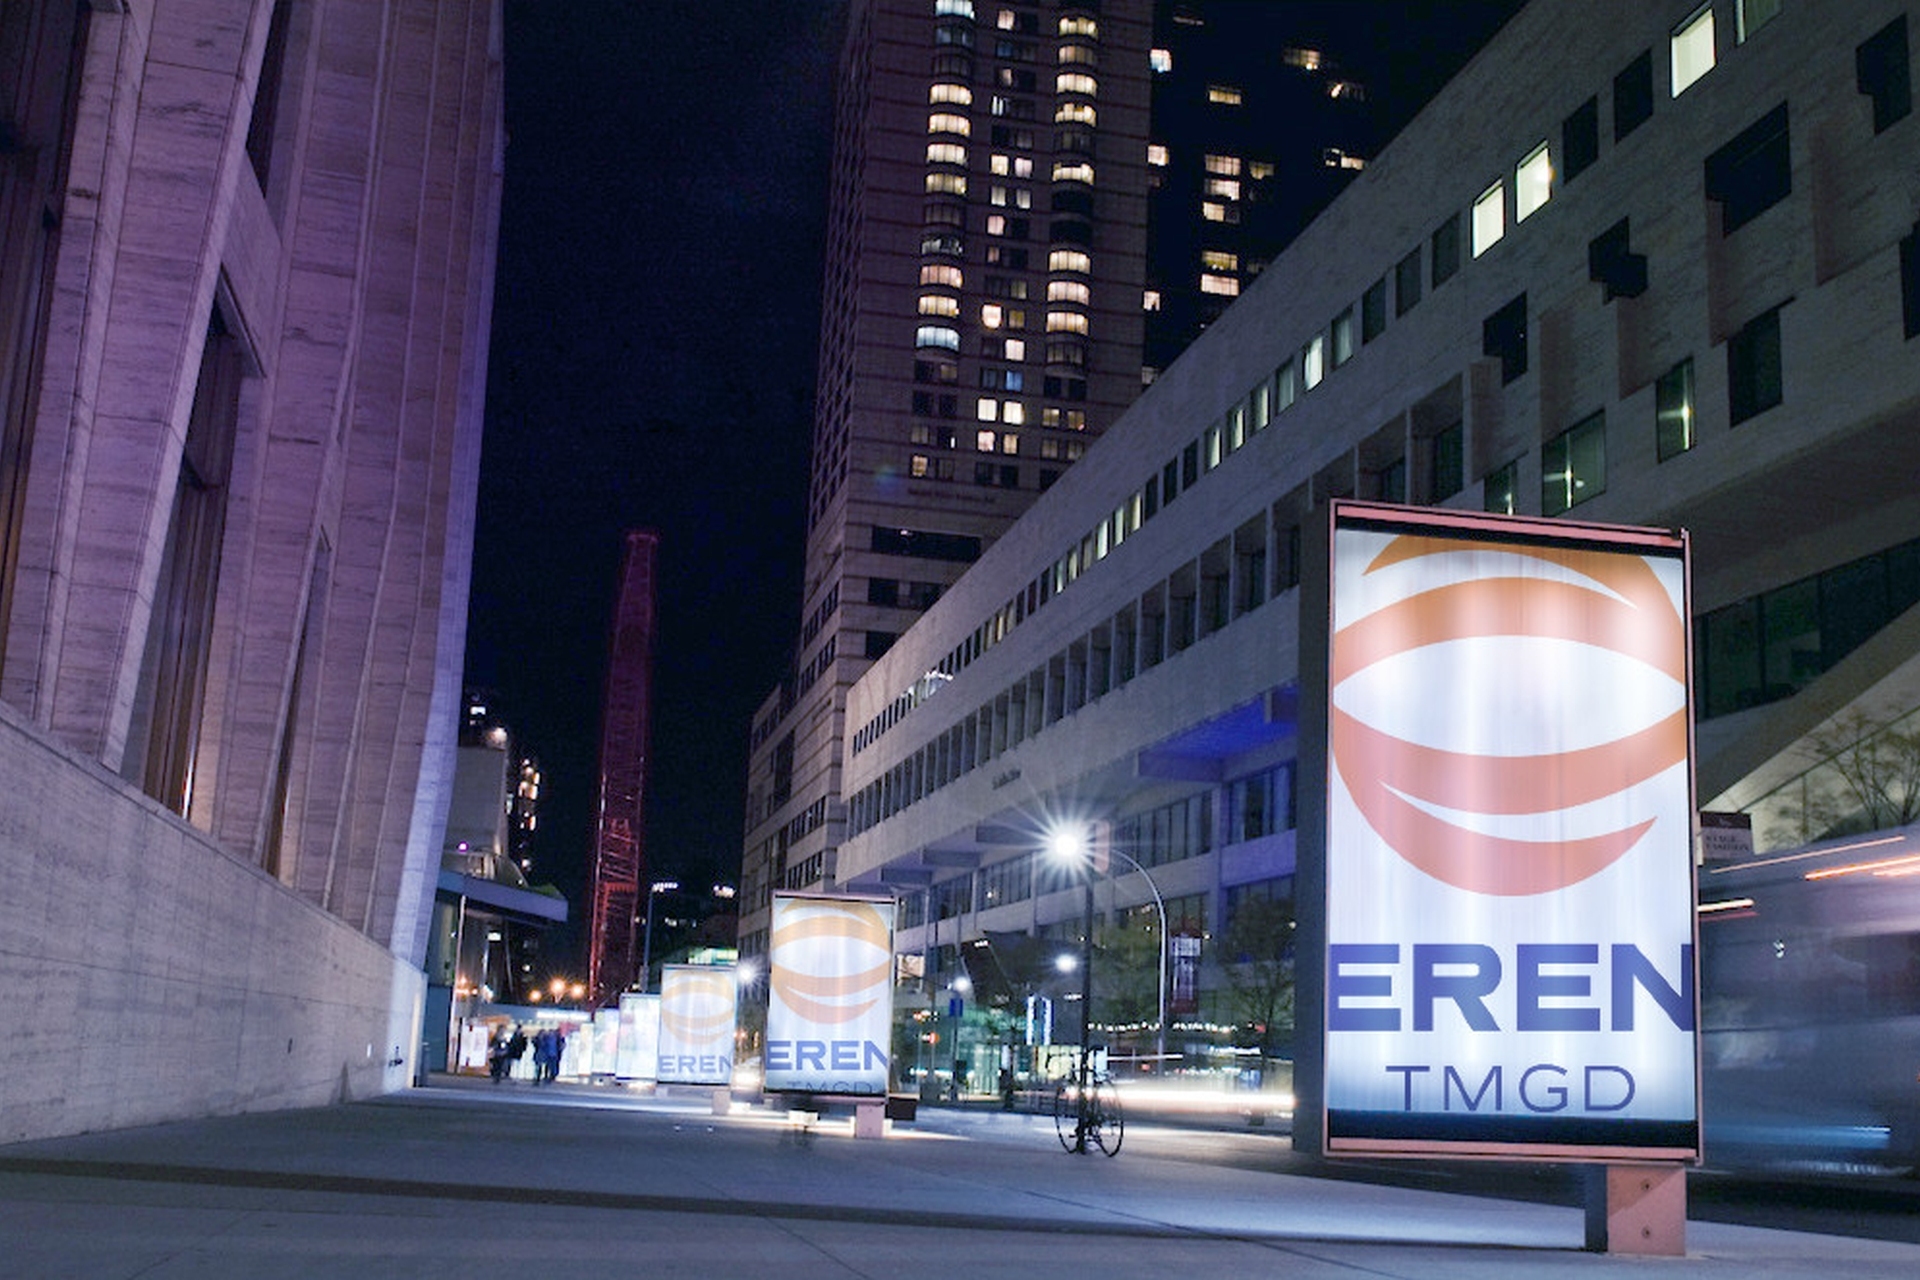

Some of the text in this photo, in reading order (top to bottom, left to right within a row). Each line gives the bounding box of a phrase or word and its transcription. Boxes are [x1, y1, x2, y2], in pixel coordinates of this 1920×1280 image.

[1328, 943, 1694, 1032] EREN
[658, 1055, 732, 1074] EREN
[765, 1040, 888, 1071] EREN
[1385, 1063, 1636, 1113] TMGD
